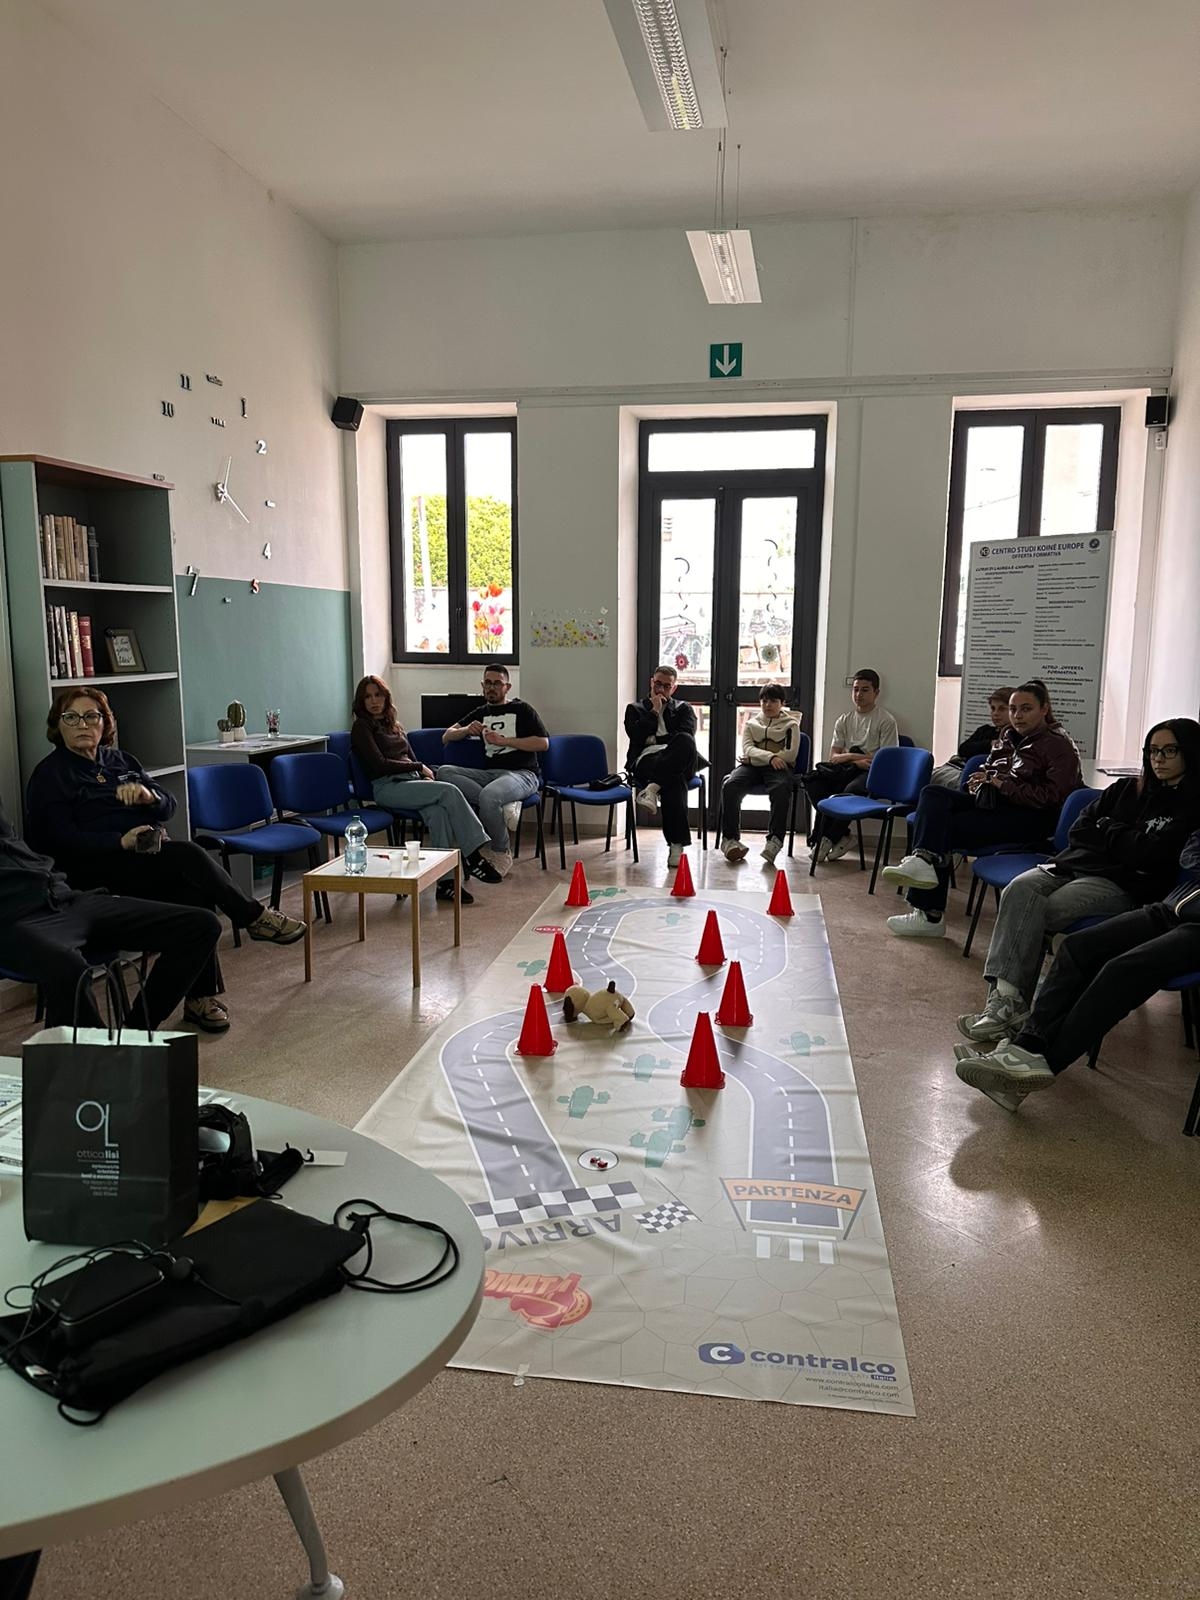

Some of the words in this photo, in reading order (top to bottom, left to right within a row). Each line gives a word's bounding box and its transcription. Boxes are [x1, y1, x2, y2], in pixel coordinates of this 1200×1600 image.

[180, 373, 192, 391] 11
[161, 400, 174, 418] 10
[240, 397, 248, 419] 1
[255, 439, 267, 455] 2
[262, 541, 272, 560] 4
[991, 547, 1016, 555] CENTRO
[1017, 545, 1037, 553] STUDI
[1037, 543, 1057, 552] KOINÉ
[1058, 542, 1085, 550] EUROPE
[186, 565, 200, 597] 7
[250, 579, 261, 594] 5
[733, 1185, 852, 1205] PARTENZA
[751, 1350, 896, 1375] contralco
[874, 1374, 895, 1382] italia
[818, 1385, 900, 1398] italia@contralco.com
